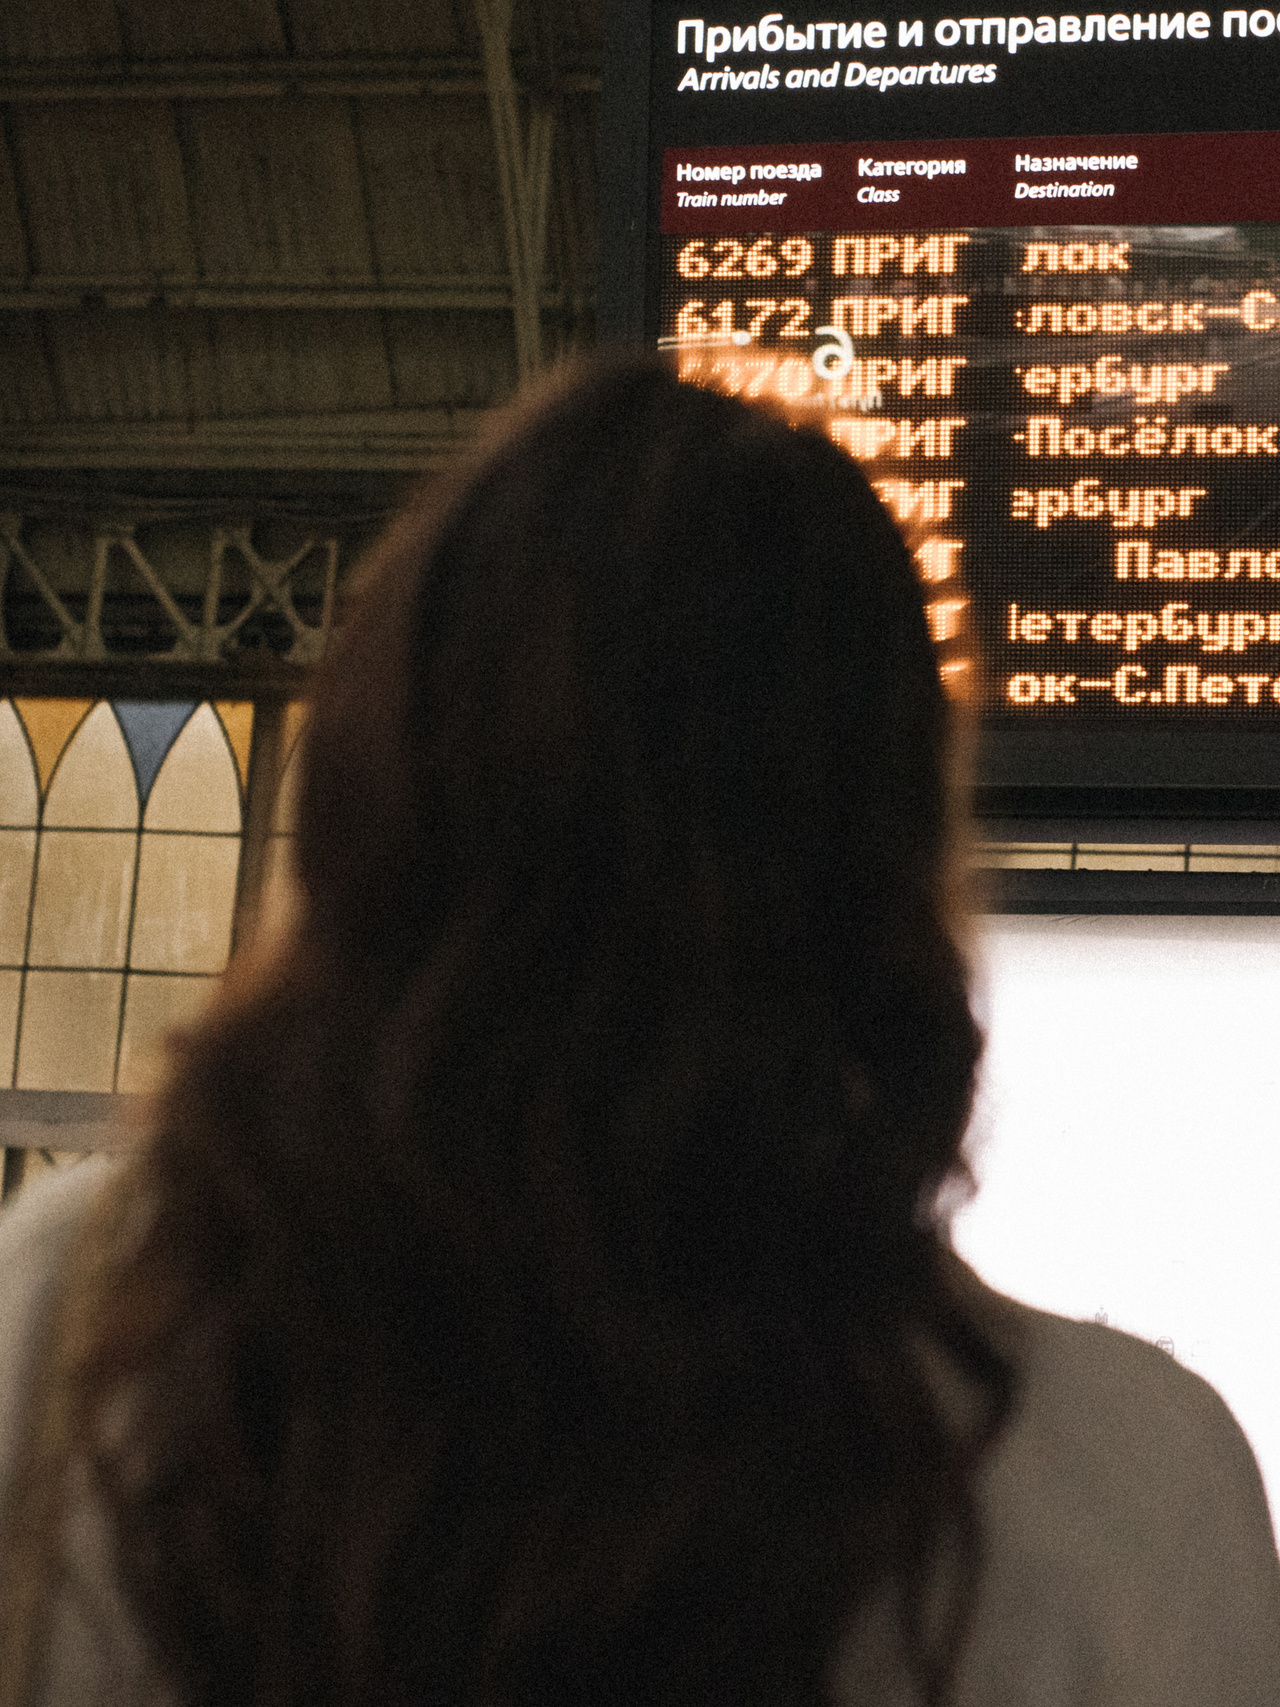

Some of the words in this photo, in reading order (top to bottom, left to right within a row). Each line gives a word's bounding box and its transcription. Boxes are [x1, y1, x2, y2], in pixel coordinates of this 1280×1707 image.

[677, 13, 887, 62] Прибытие
[898, 20, 924, 48] и
[934, 11, 1212, 55] отправление
[677, 63, 781, 92] Arrivals
[785, 61, 840, 89] and
[843, 61, 998, 93] Departures
[676, 163, 746, 184] Номер
[749, 163, 823, 183] поезда
[857, 157, 967, 180] Категория
[1014, 154, 1139, 173] Назначение
[676, 191, 718, 208] Train
[720, 188, 788, 207] number
[856, 185, 901, 204] Class
[1014, 180, 1116, 200] Destination
[678, 239, 812, 278] 6269
[834, 235, 969, 275] ПРИГ
[1022, 241, 1130, 271] лок
[677, 299, 811, 338] 6172
[833, 296, 968, 336] ПРИГ
